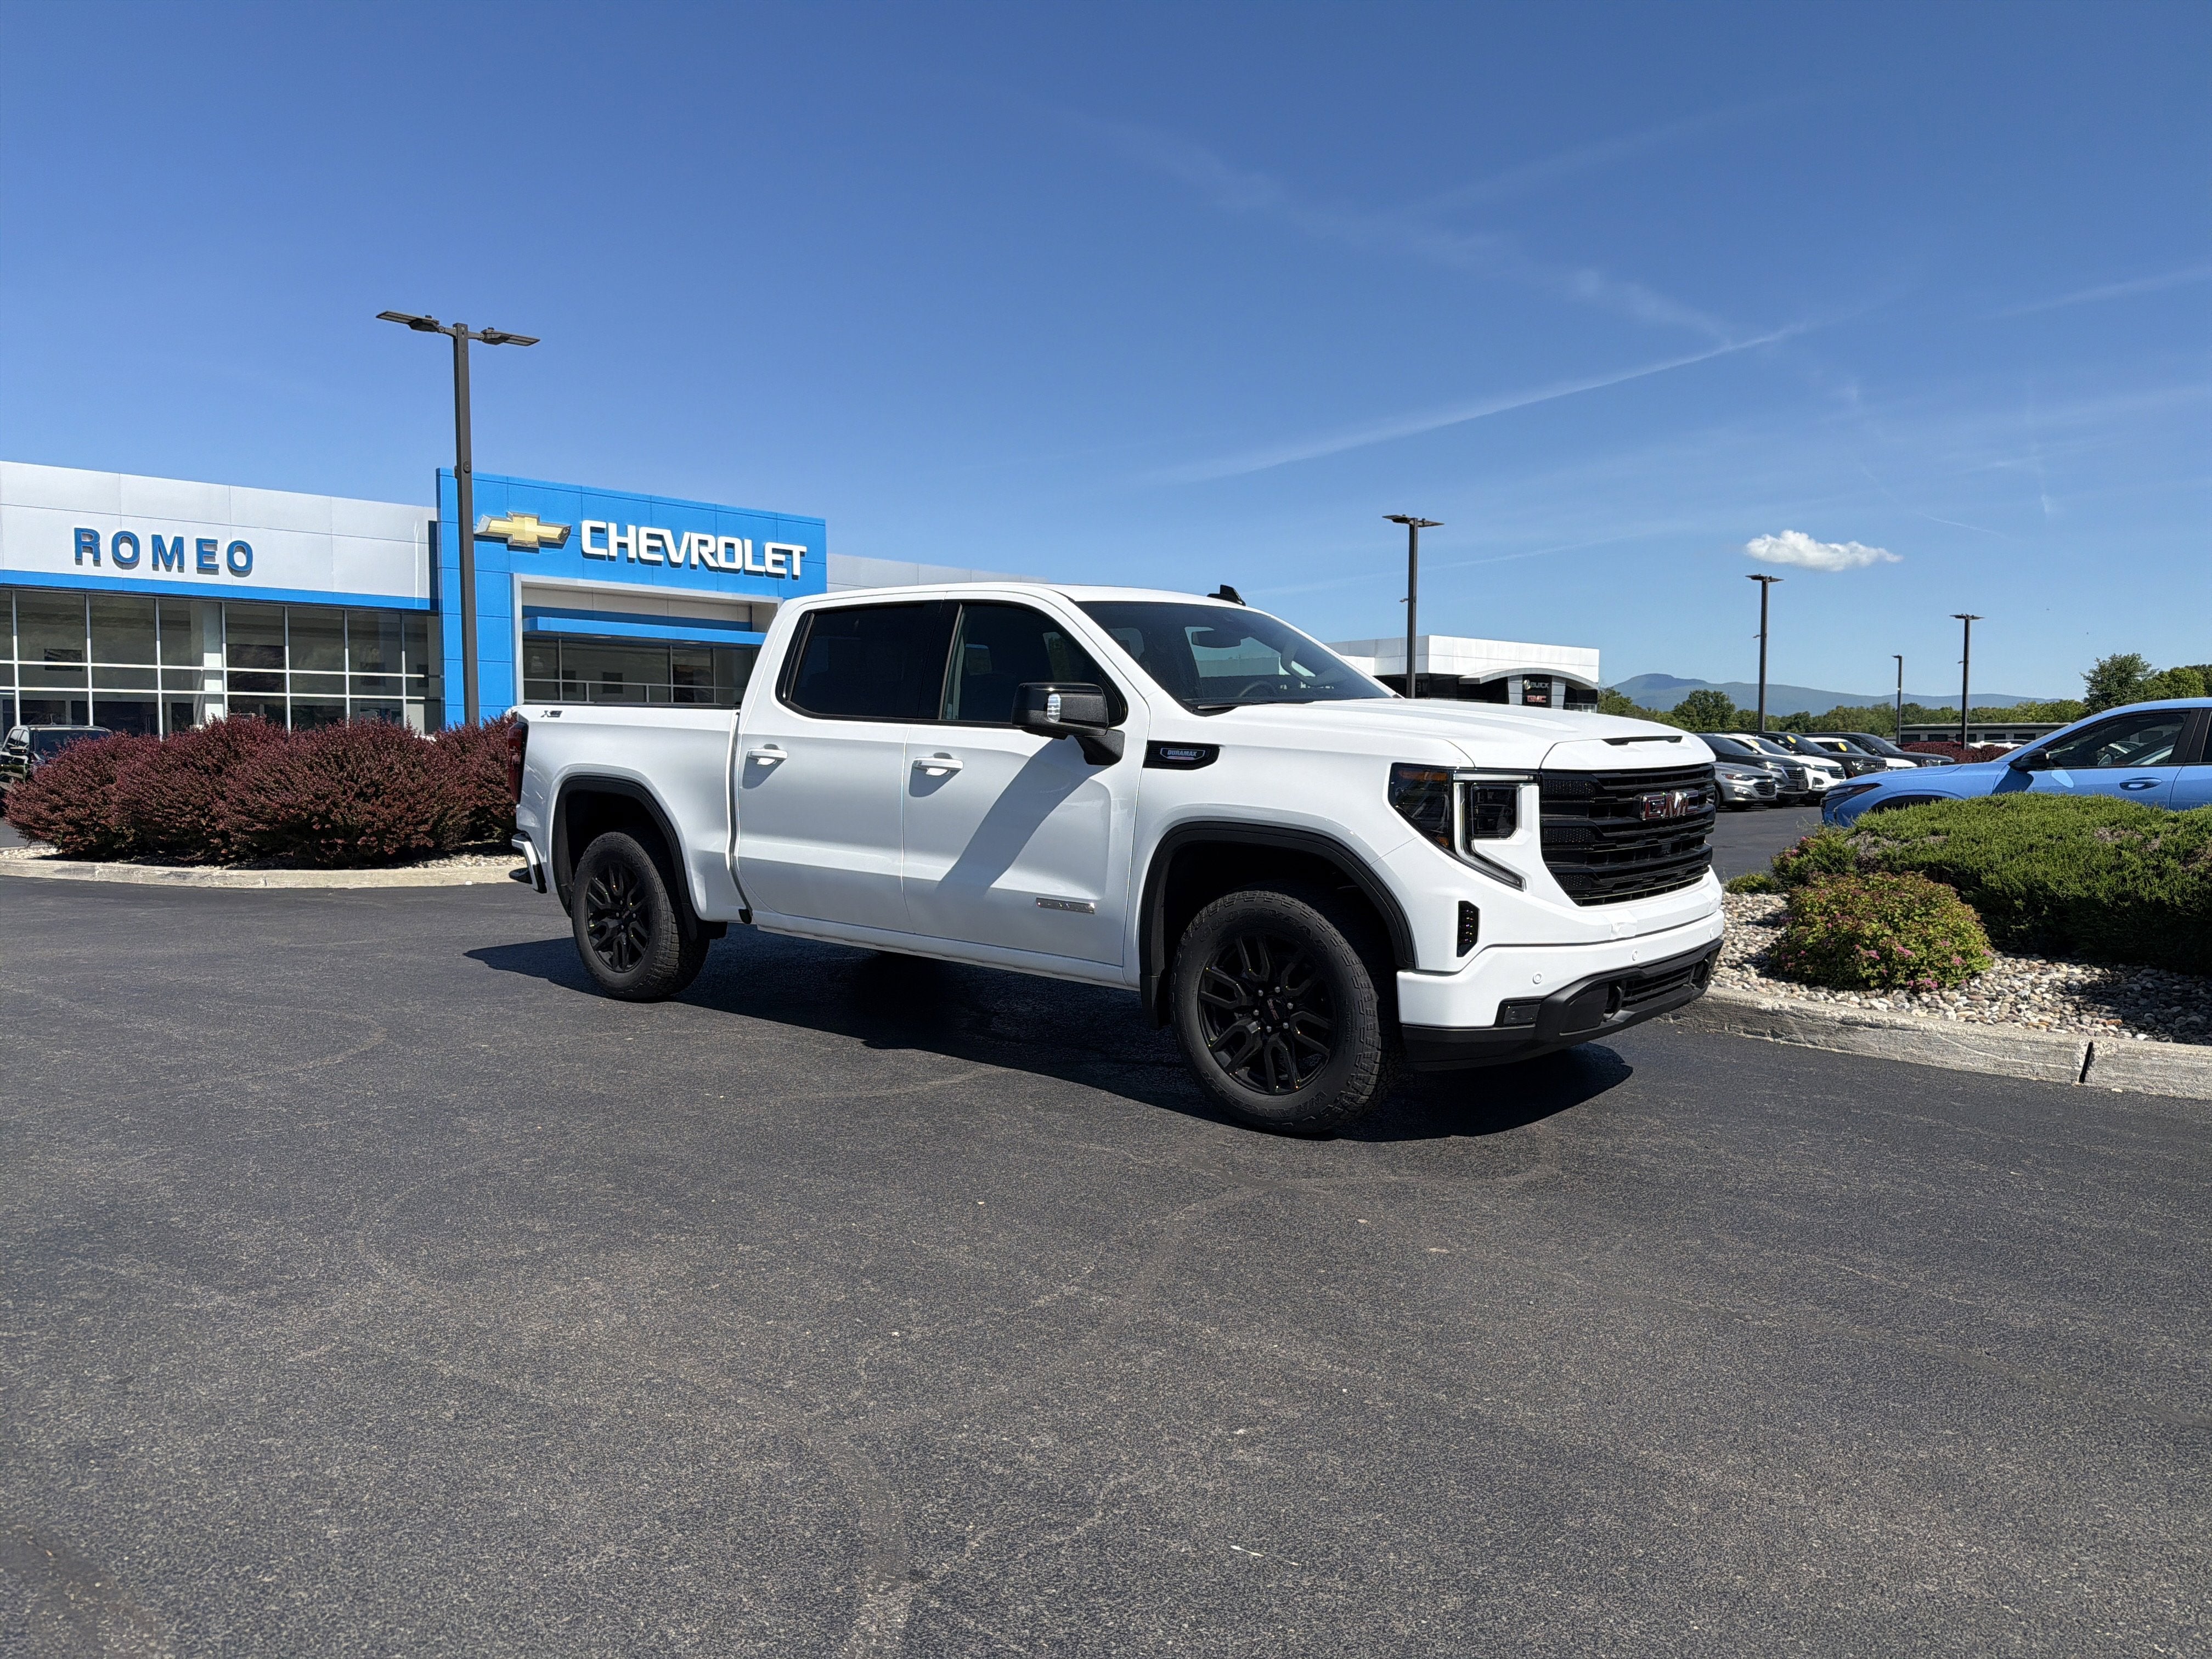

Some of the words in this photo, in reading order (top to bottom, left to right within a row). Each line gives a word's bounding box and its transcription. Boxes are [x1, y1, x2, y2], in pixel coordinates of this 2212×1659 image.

[74, 527, 253, 574] ROMEO
[582, 520, 807, 578] CHEVROLET
[1640, 789, 1699, 821] GMC
[1200, 907, 1329, 954] GOODYEAR
